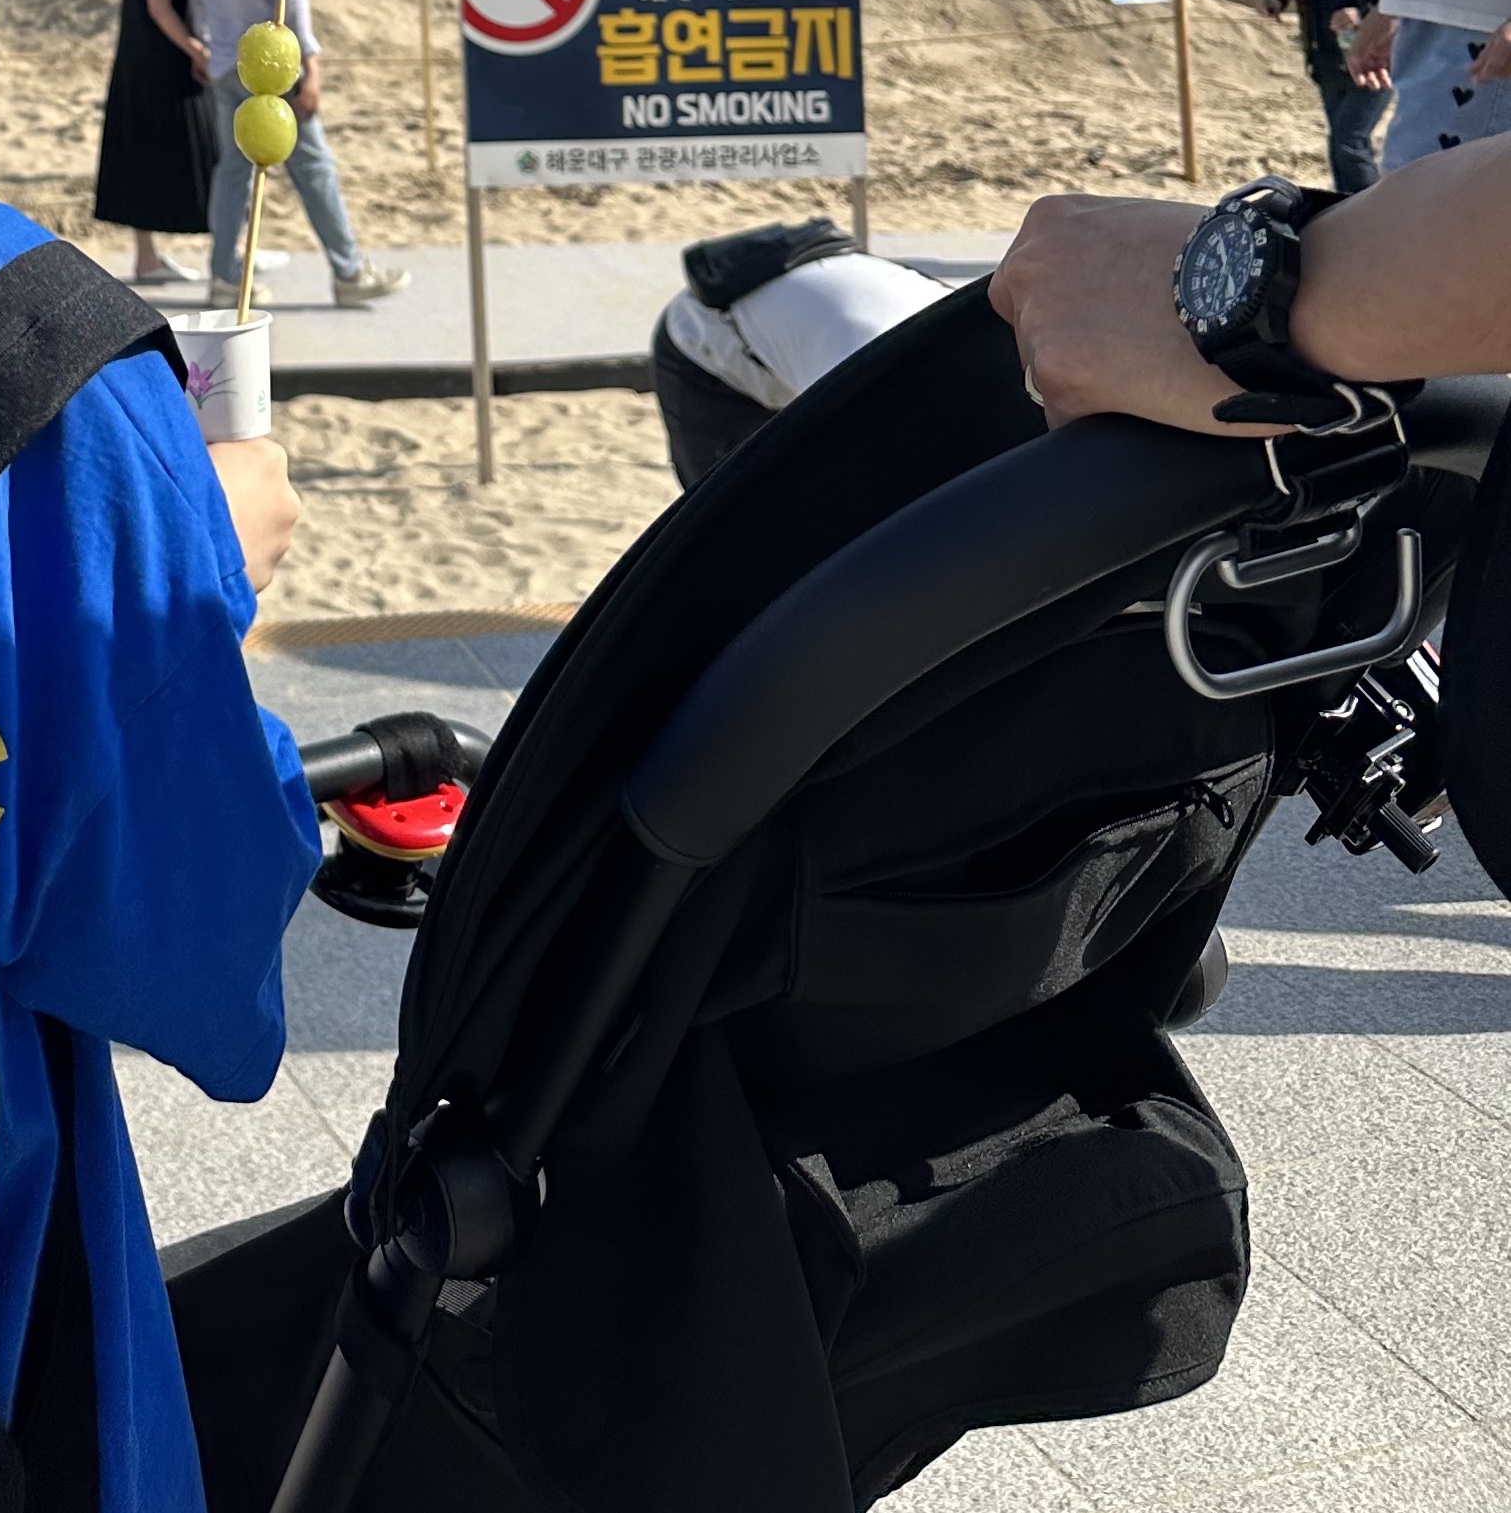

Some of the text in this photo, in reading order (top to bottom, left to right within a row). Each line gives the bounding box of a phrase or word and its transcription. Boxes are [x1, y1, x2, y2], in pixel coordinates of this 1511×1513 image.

[596, 7, 855, 86] 흡연금지
[622, 90, 831, 129] NO SMOKING
[545, 142, 821, 174] 해운대구 관광시설관리사업소
[1254, 228, 1268, 246] 50
[1197, 318, 1208, 333] 10
